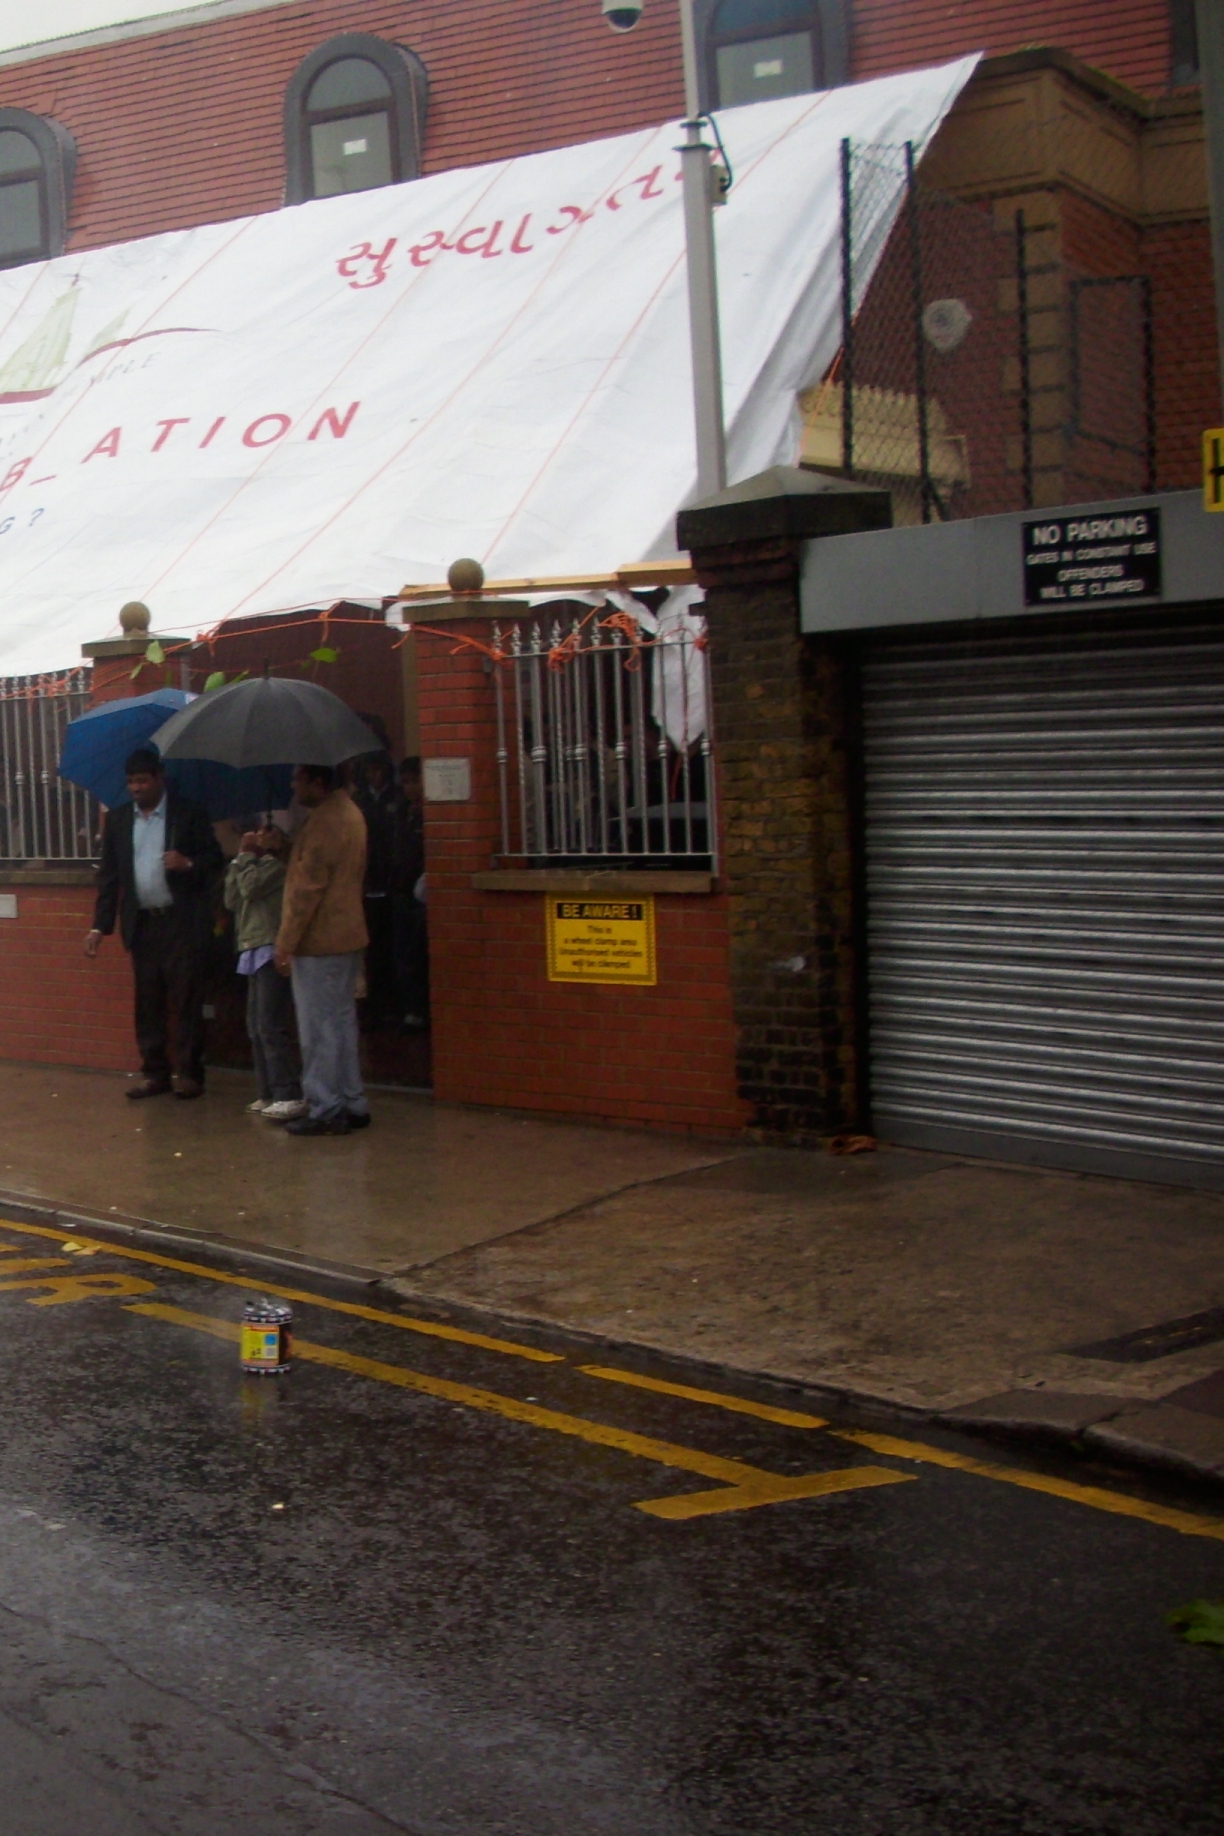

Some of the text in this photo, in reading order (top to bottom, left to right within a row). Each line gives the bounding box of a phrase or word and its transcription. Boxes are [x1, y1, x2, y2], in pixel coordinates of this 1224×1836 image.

[1032, 515, 1148, 546] NO PARKING
[1069, 583, 1086, 597] BE
[1089, 579, 1145, 595] CLAMPED
[562, 904, 580, 917] BE
